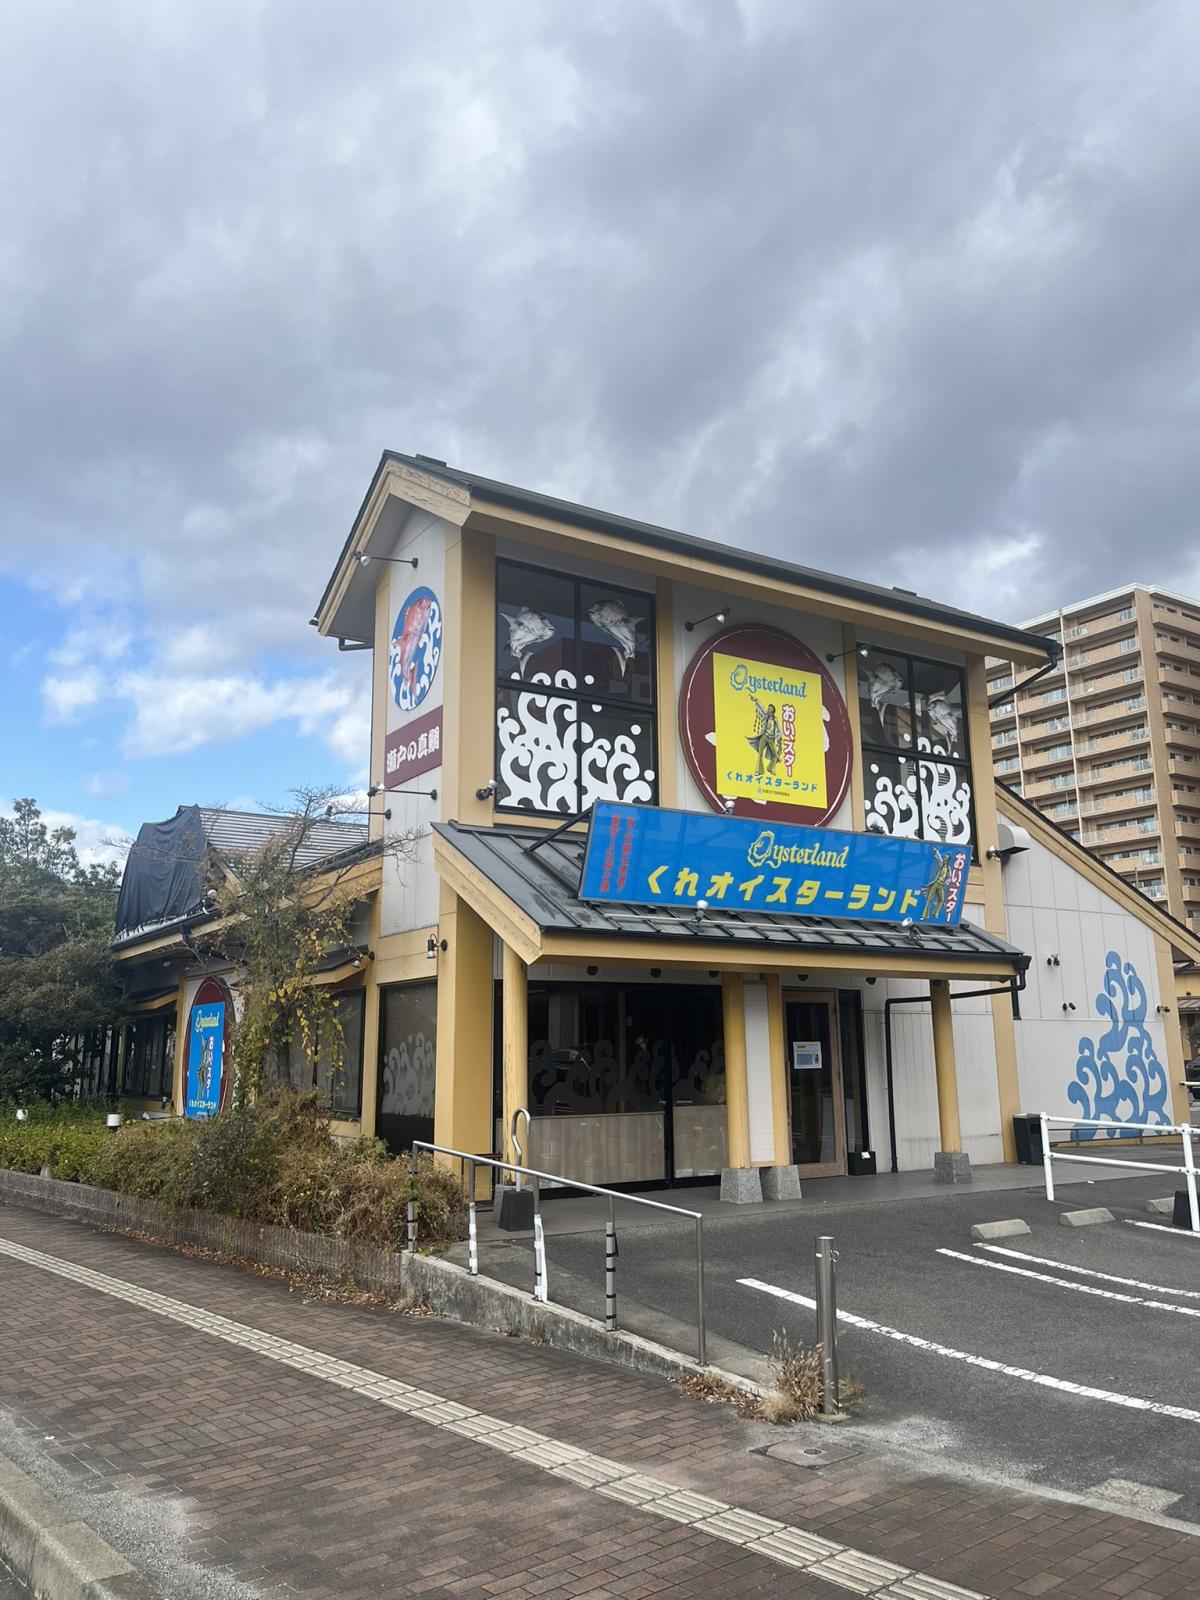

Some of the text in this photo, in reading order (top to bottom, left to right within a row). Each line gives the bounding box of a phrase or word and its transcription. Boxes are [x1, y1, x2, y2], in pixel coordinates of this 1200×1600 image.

[729, 663, 807, 699] Oysterland
[386, 726, 440, 773] 瀬戸の真鯛
[726, 770, 818, 793] くれオイスターランド
[747, 830, 850, 869] Oysterland
[646, 865, 922, 915] くれオイスターランド
